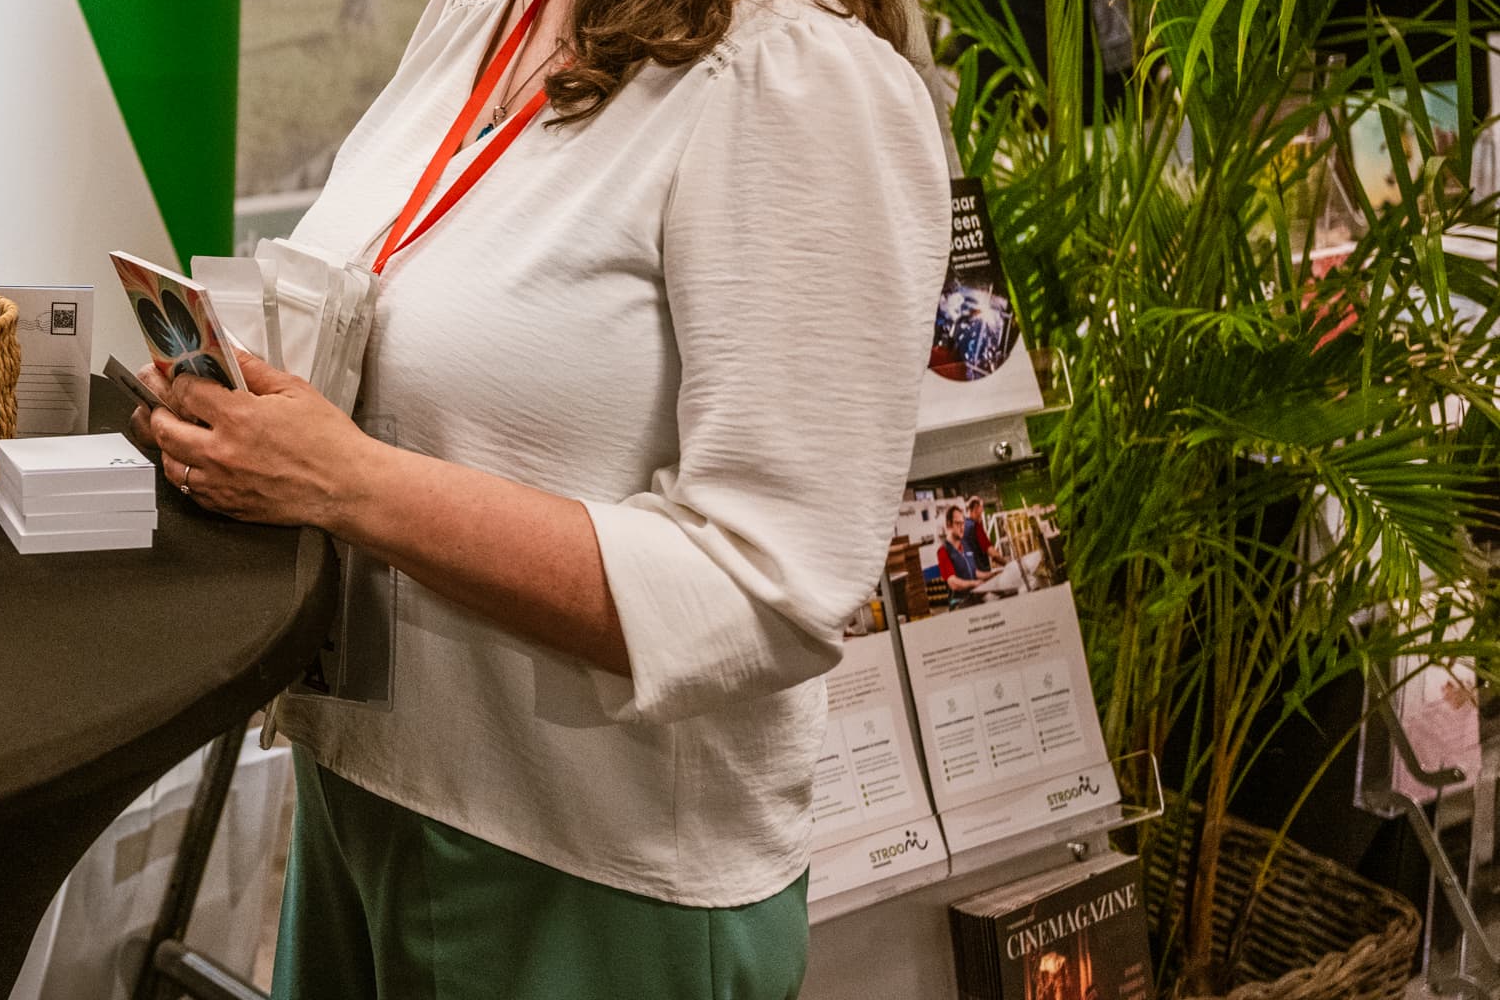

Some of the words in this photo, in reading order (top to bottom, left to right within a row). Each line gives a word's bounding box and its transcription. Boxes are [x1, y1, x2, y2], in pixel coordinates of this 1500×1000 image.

[952, 195, 976, 212] aar
[869, 830, 928, 863] STROOM
[1006, 883, 1138, 961] CINEMAGAZINE
